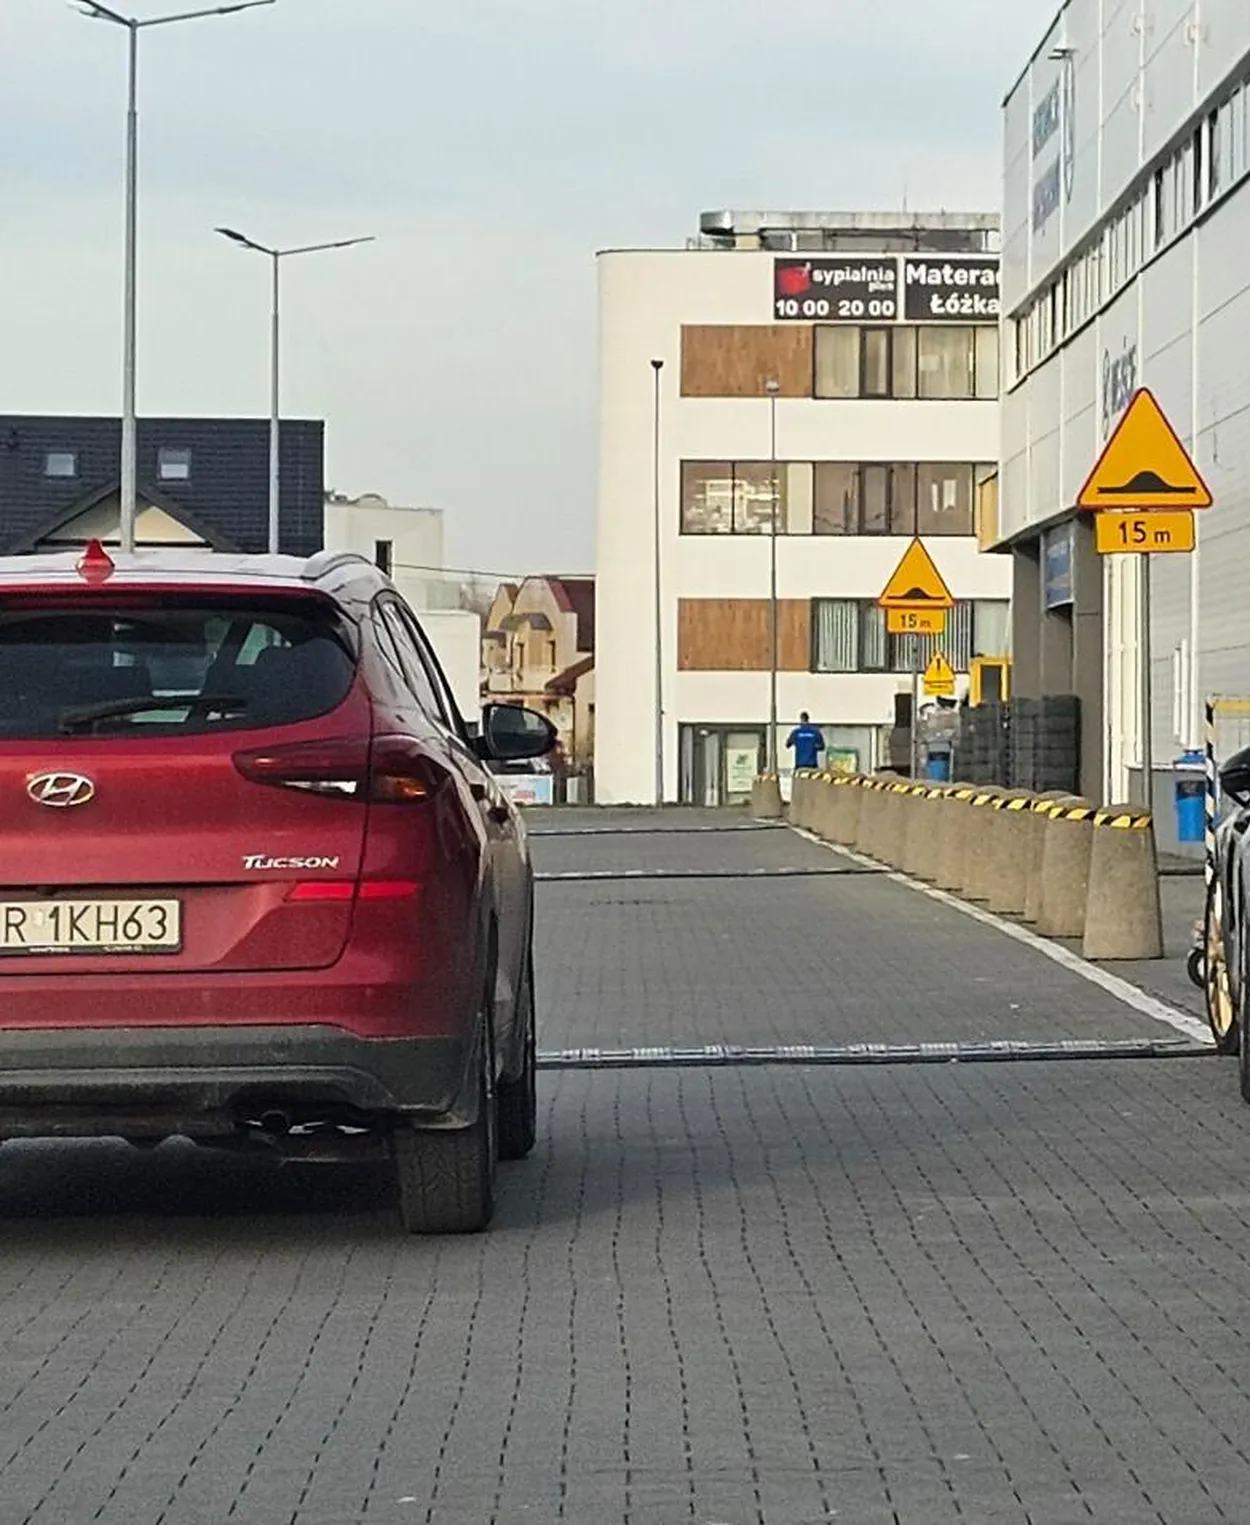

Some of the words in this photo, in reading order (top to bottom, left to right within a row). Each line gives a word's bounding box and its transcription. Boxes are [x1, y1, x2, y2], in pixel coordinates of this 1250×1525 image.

[812, 264, 895, 286] sypialnia
[776, 299, 798, 316] 10
[803, 299, 829, 316] 00
[838, 299, 864, 316] 20
[868, 299, 895, 316] 00
[930, 293, 1000, 315] Łóżka
[1118, 521, 1147, 544] 15
[1154, 530, 1171, 543] m
[900, 613, 917, 629] 15
[49, 905, 167, 942] 1KH63
